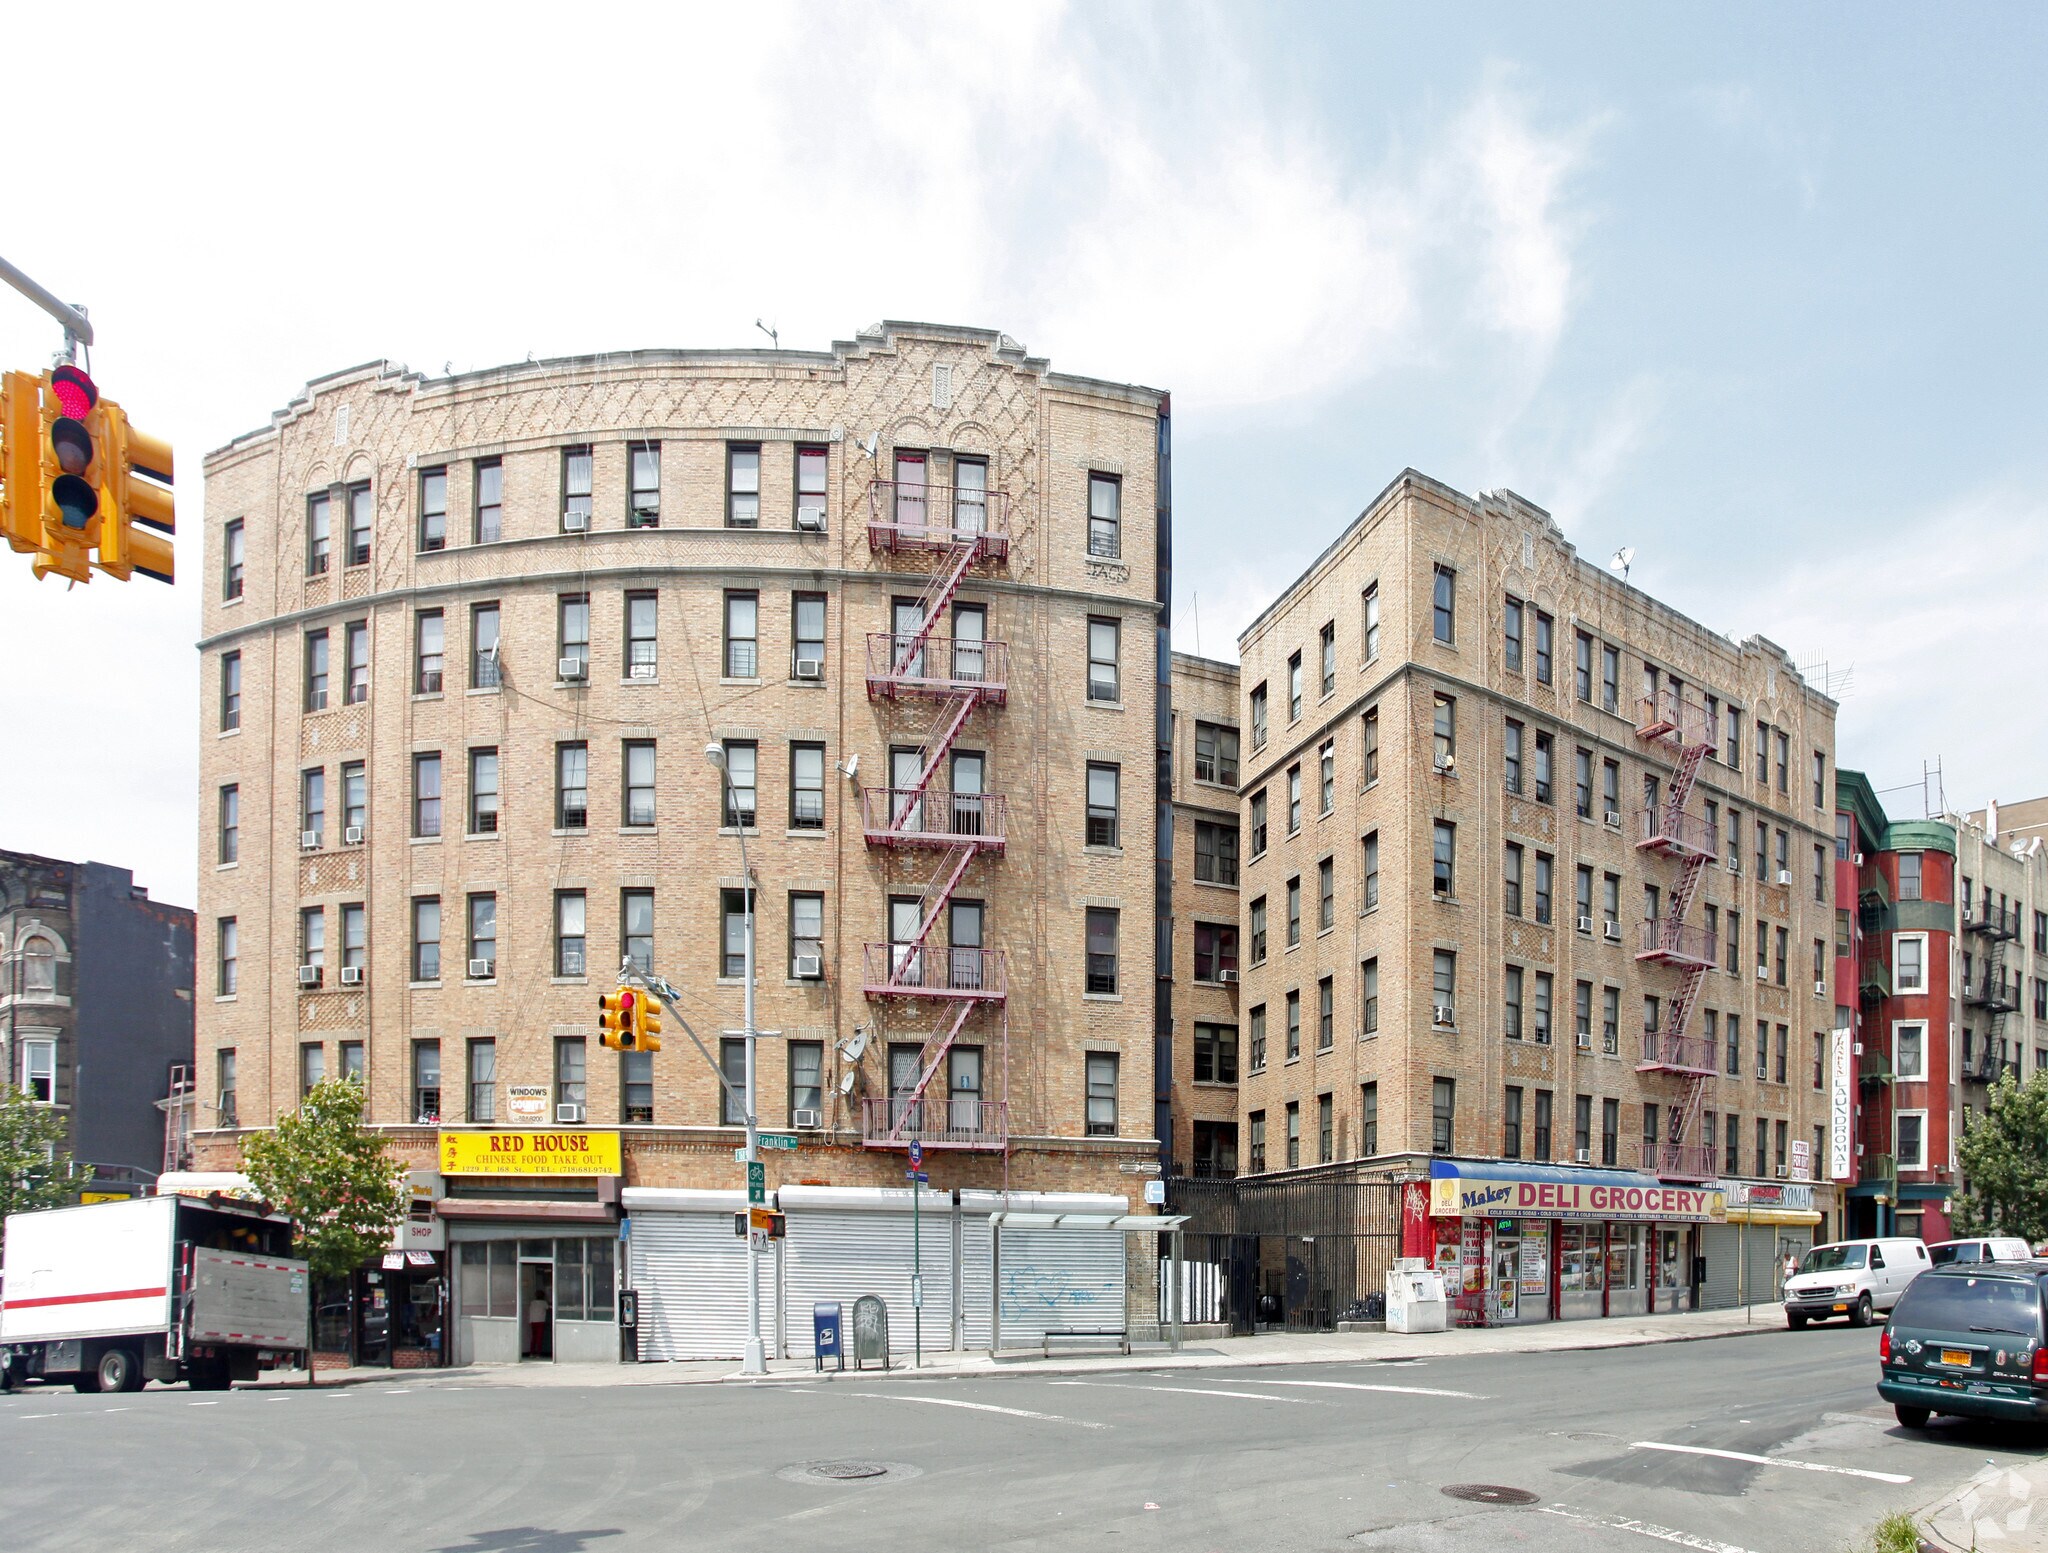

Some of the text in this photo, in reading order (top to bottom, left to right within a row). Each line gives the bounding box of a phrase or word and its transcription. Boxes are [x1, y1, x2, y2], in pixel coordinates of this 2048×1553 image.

[510, 1088, 548, 1096] WINDOWS
[1834, 1079, 1847, 1172] LAUNDROMAT
[489, 1134, 589, 1152] RED HOUSE
[757, 1135, 788, 1148] Franklin
[1794, 1143, 1808, 1154] STORE
[475, 1154, 604, 1165] CHINESE FOOD TAKE OUT
[1461, 1183, 1707, 1212] Makey DELI GROCERY
[1434, 1207, 1459, 1215] GROCERY
[1463, 1221, 1472, 1230] We
[1498, 1220, 1512, 1230] ATM
[411, 1227, 432, 1237] SHOP
[1463, 1231, 1476, 1239] FOOD
